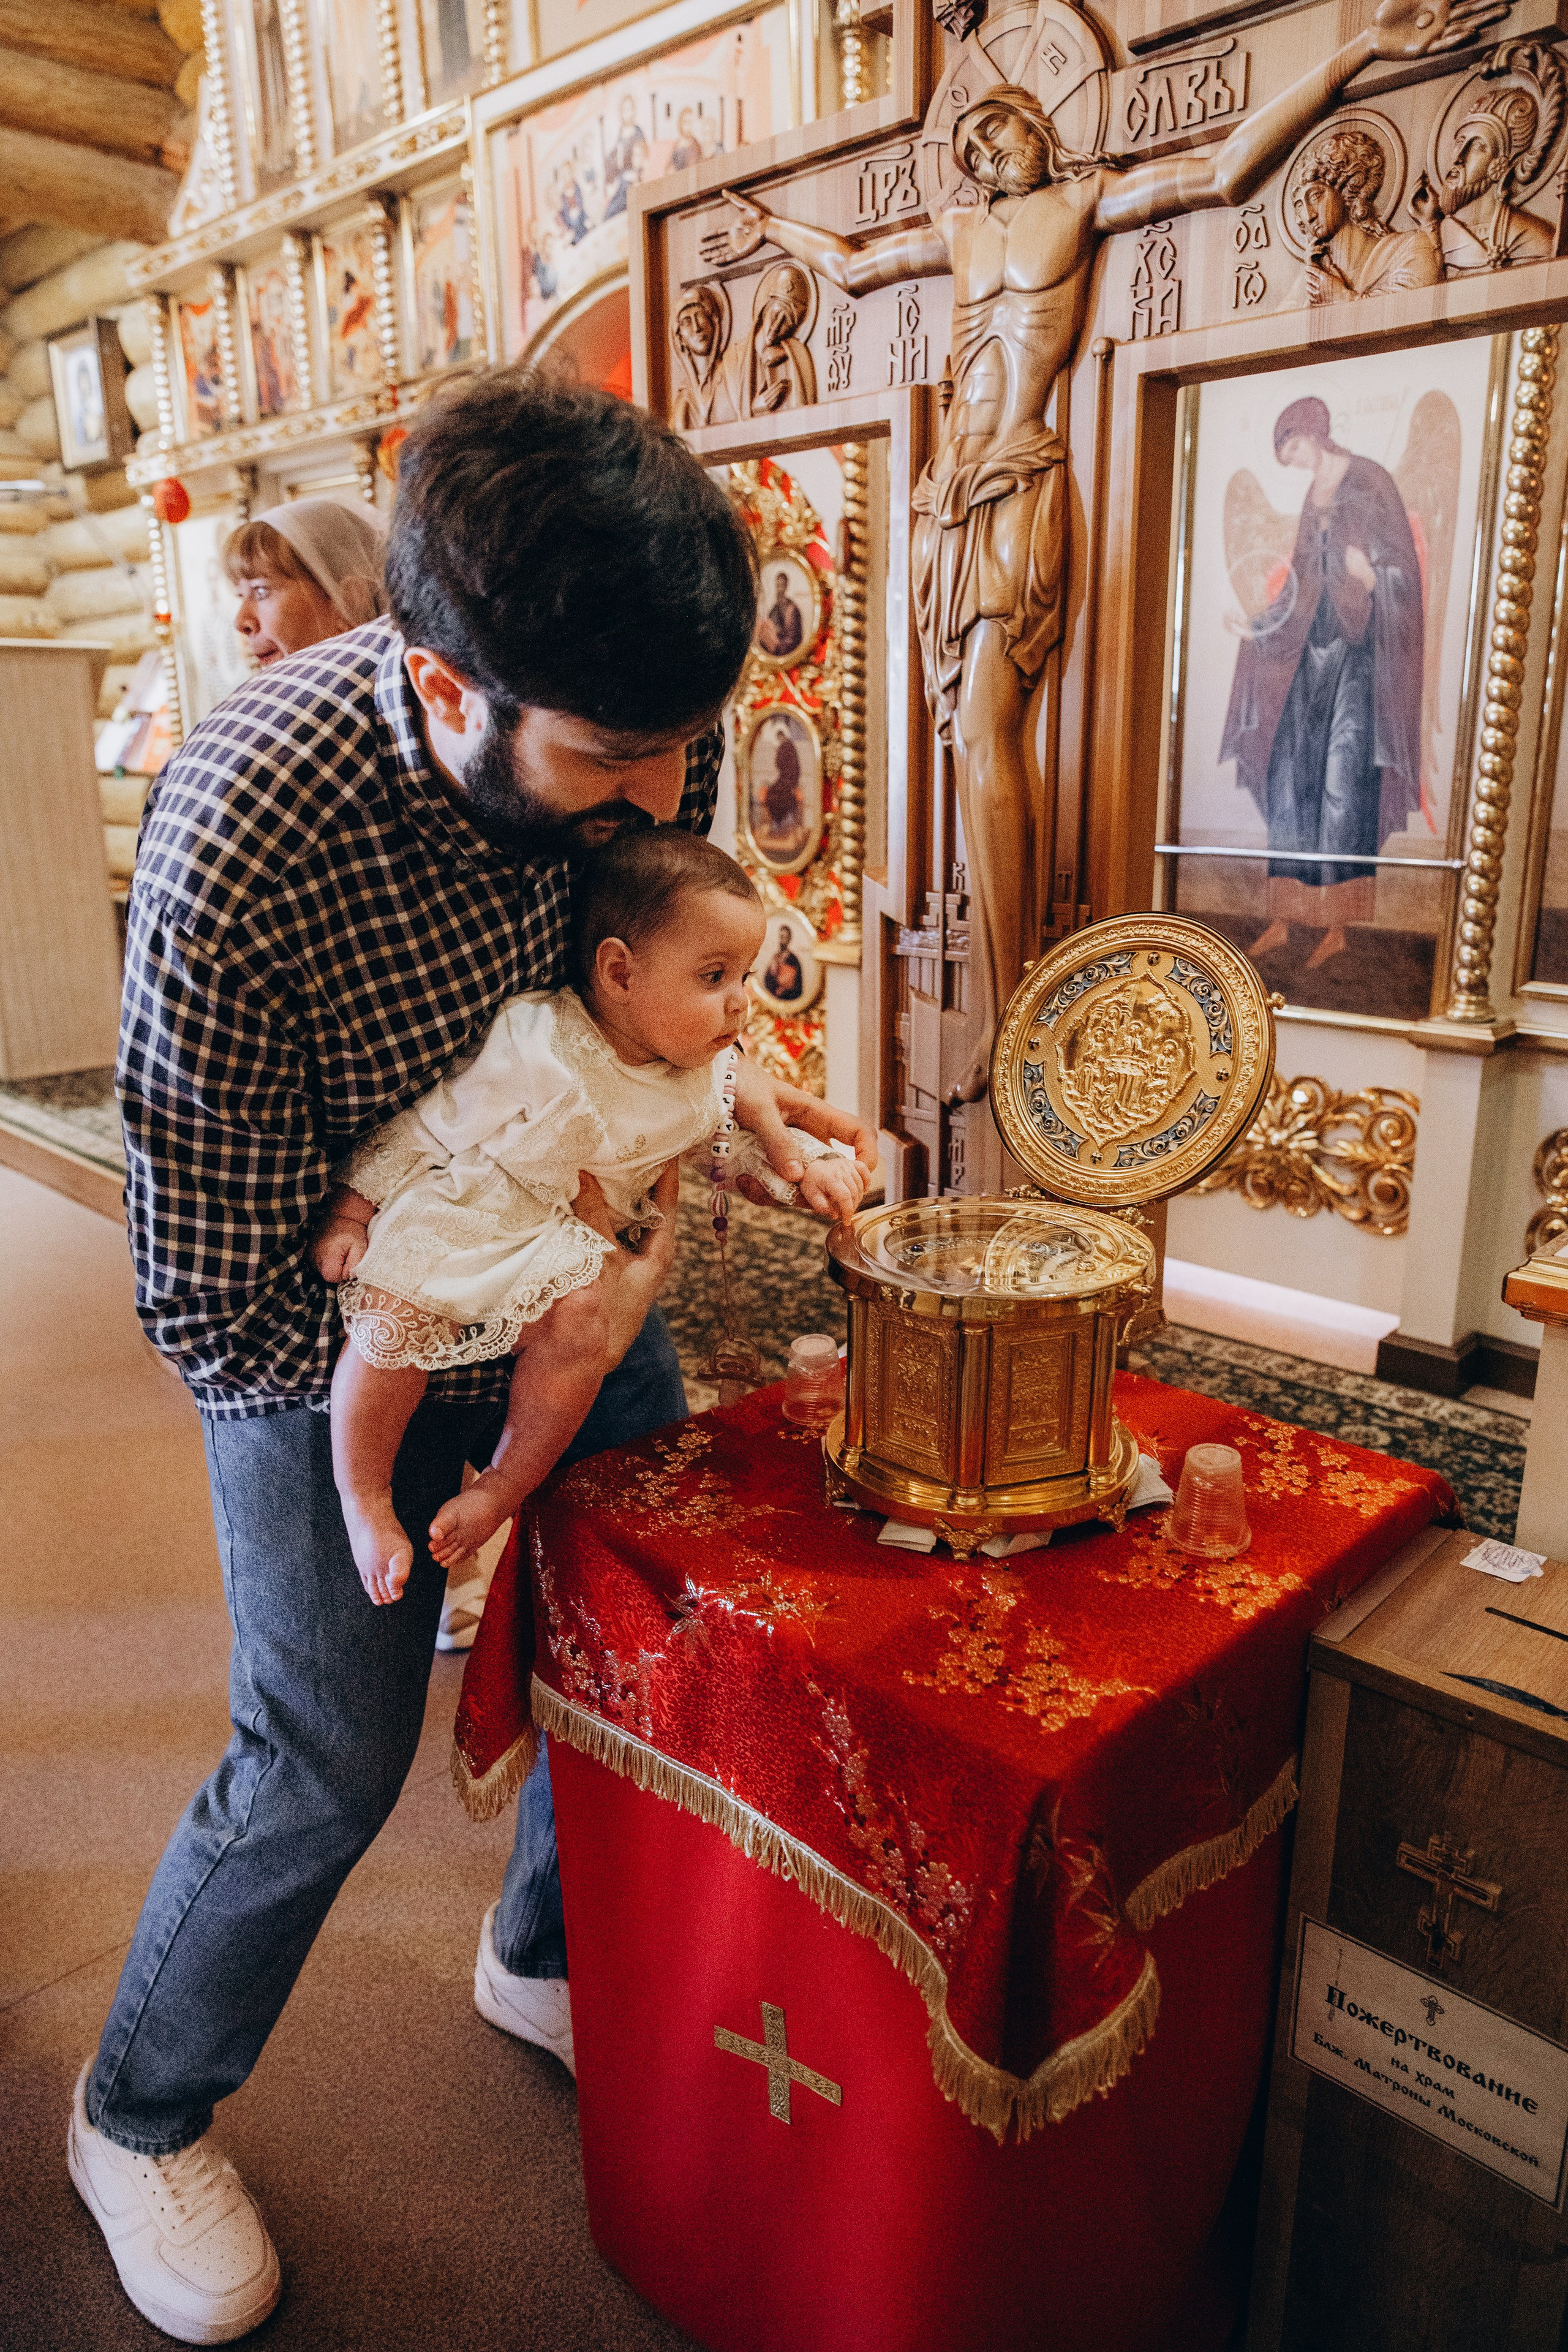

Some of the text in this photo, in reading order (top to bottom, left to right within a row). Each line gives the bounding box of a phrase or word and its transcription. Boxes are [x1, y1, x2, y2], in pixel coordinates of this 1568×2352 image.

[1313, 2031, 1539, 2168] Блж. Матроны Московской
[1325, 1983, 1539, 2115] Пожертвование
[1390, 2057, 1455, 2100] на храм
